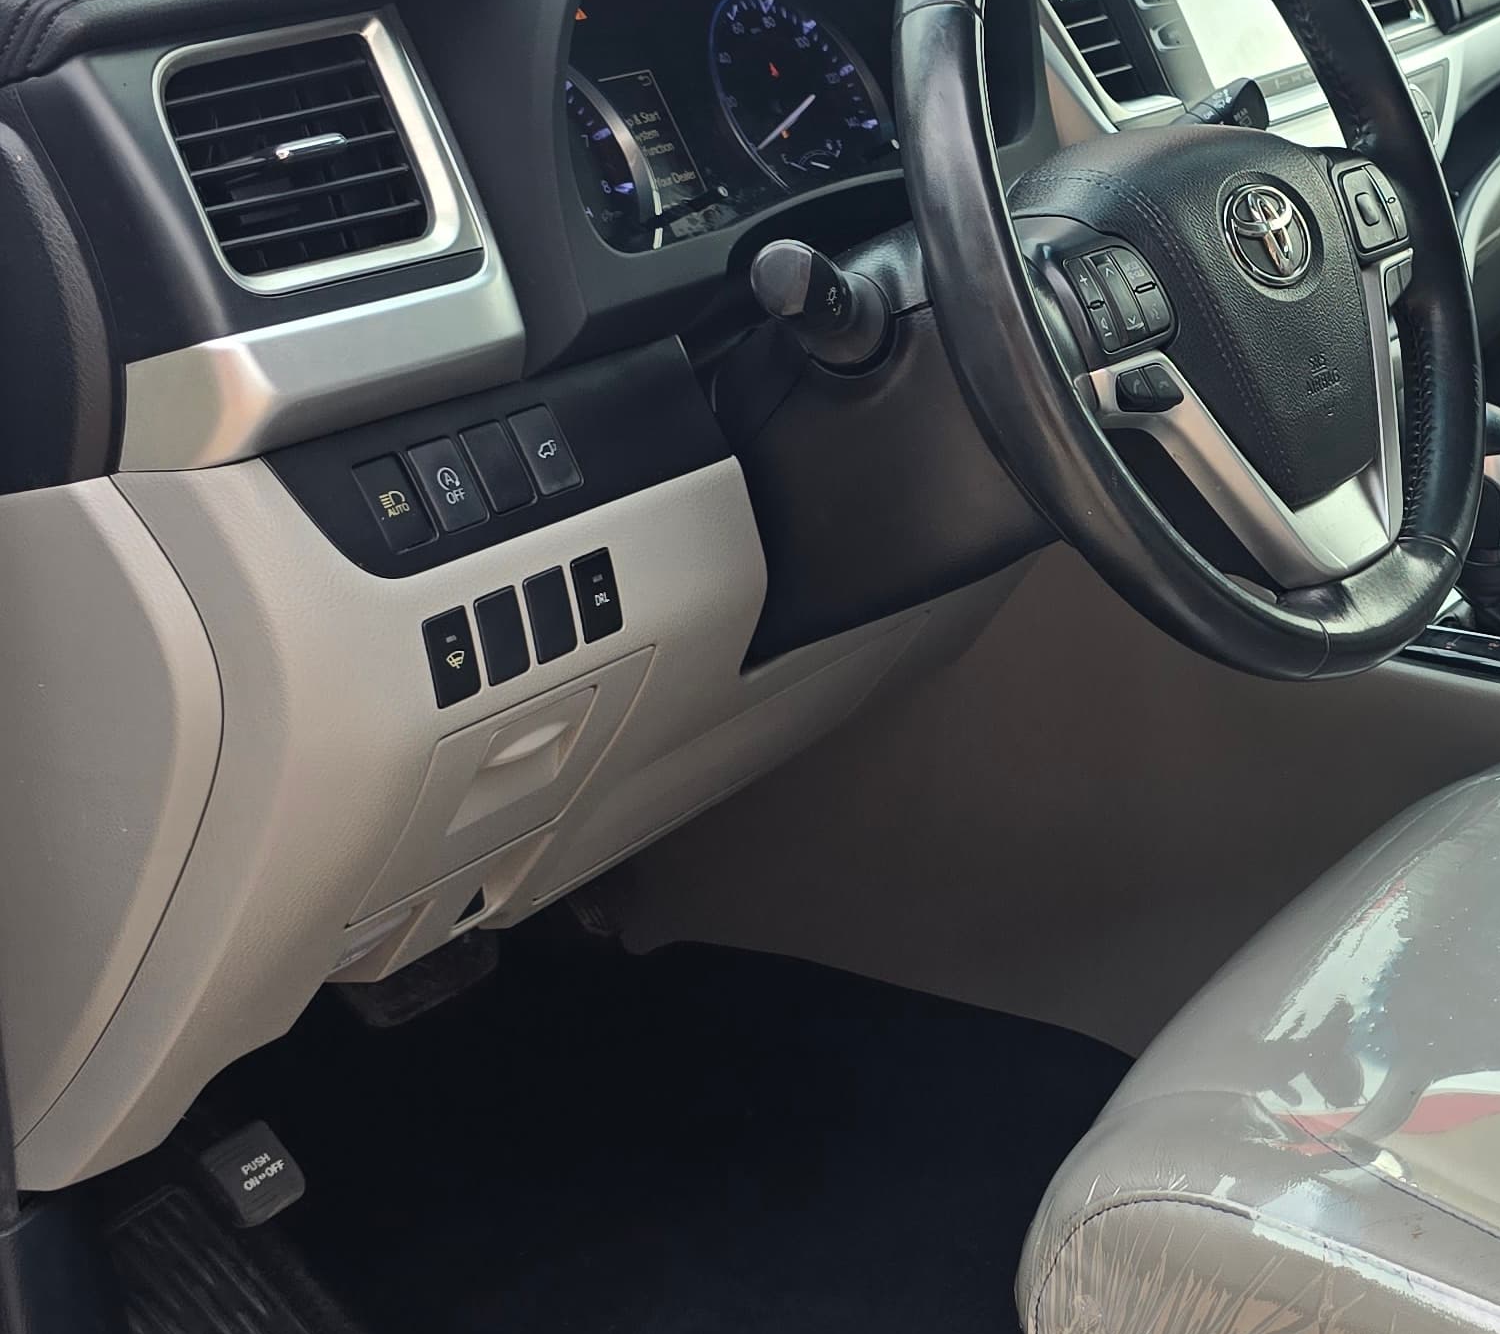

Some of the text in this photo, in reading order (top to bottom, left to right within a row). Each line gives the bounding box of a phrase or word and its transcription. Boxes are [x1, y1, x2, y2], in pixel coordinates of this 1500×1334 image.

[670, 170, 697, 185] Dealer
[600, 178, 612, 195] 8
[1306, 367, 1341, 395] AIRBAG
[446, 487, 466, 505] OFF
[387, 502, 411, 518] AUTO
[594, 591, 611, 607] DRL
[241, 1152, 271, 1176] PUSH
